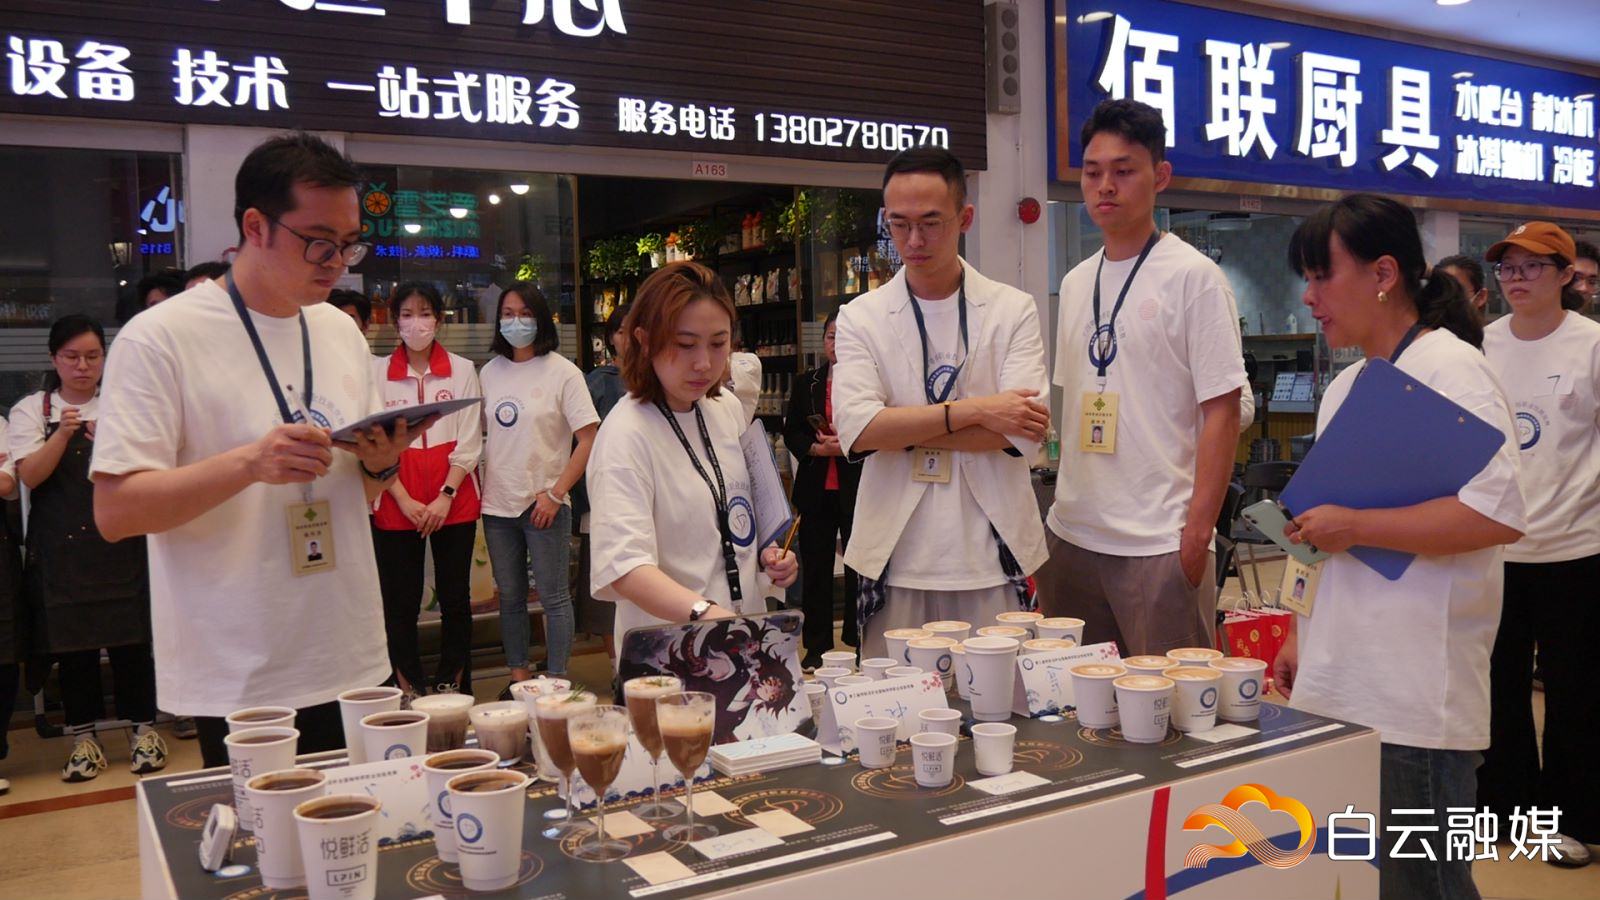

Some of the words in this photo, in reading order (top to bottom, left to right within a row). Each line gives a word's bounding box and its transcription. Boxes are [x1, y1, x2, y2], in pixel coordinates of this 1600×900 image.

[7, 36, 135, 102] 设备
[172, 48, 290, 111] 技术
[327, 66, 580, 130] 一站式服务
[1099, 13, 1440, 178] 佰联厨具
[618, 98, 736, 141] 服务电话
[754, 113, 949, 151] 13802780670
[1456, 81, 1522, 127] 水吧台
[1532, 92, 1594, 138] 制冰机
[695, 164, 726, 176] A163
[1553, 145, 1594, 187] 冷柜
[320, 831, 371, 860] 悦鲜活
[333, 870, 361, 883] LPIN
